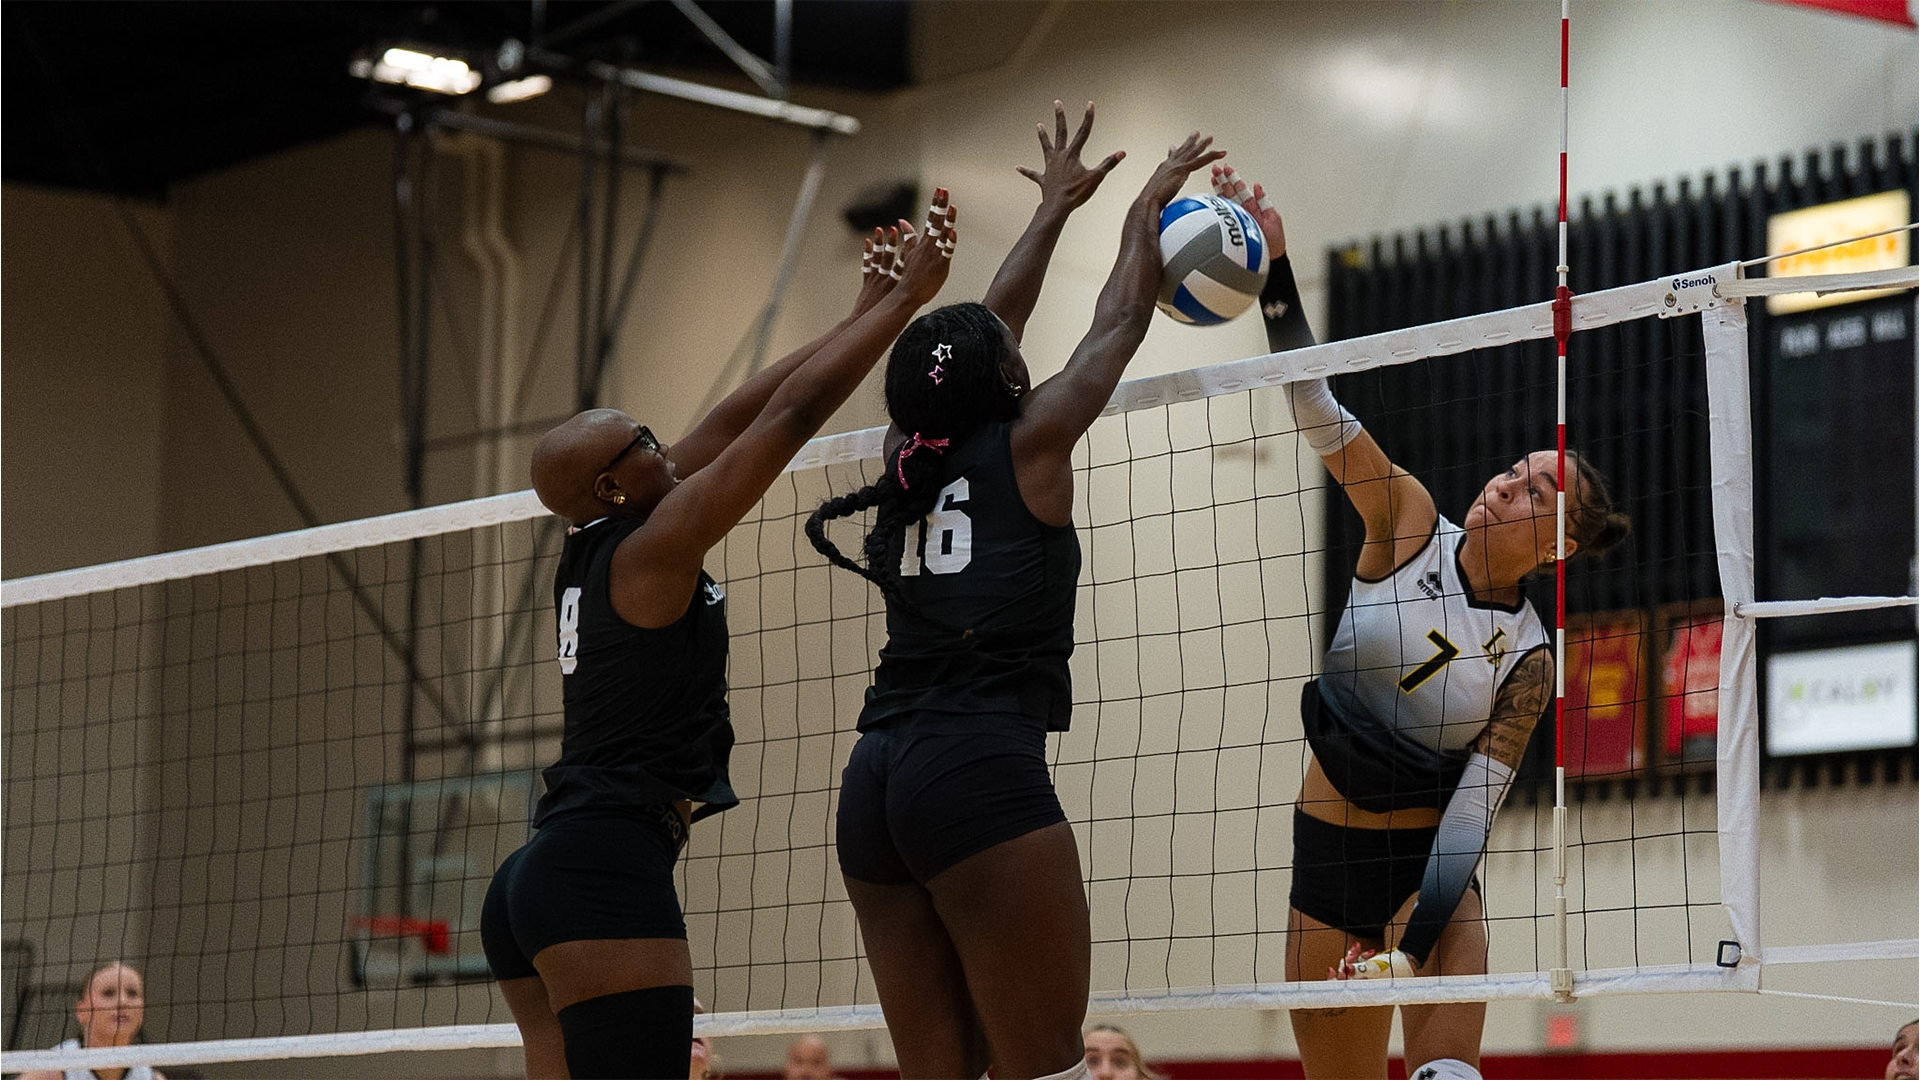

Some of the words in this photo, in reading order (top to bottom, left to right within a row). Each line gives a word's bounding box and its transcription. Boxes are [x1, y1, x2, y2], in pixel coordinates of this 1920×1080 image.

[1681, 274, 1716, 289] Senoh
[899, 476, 972, 576] 16
[558, 587, 582, 675] 8
[1396, 627, 1461, 695] 7
